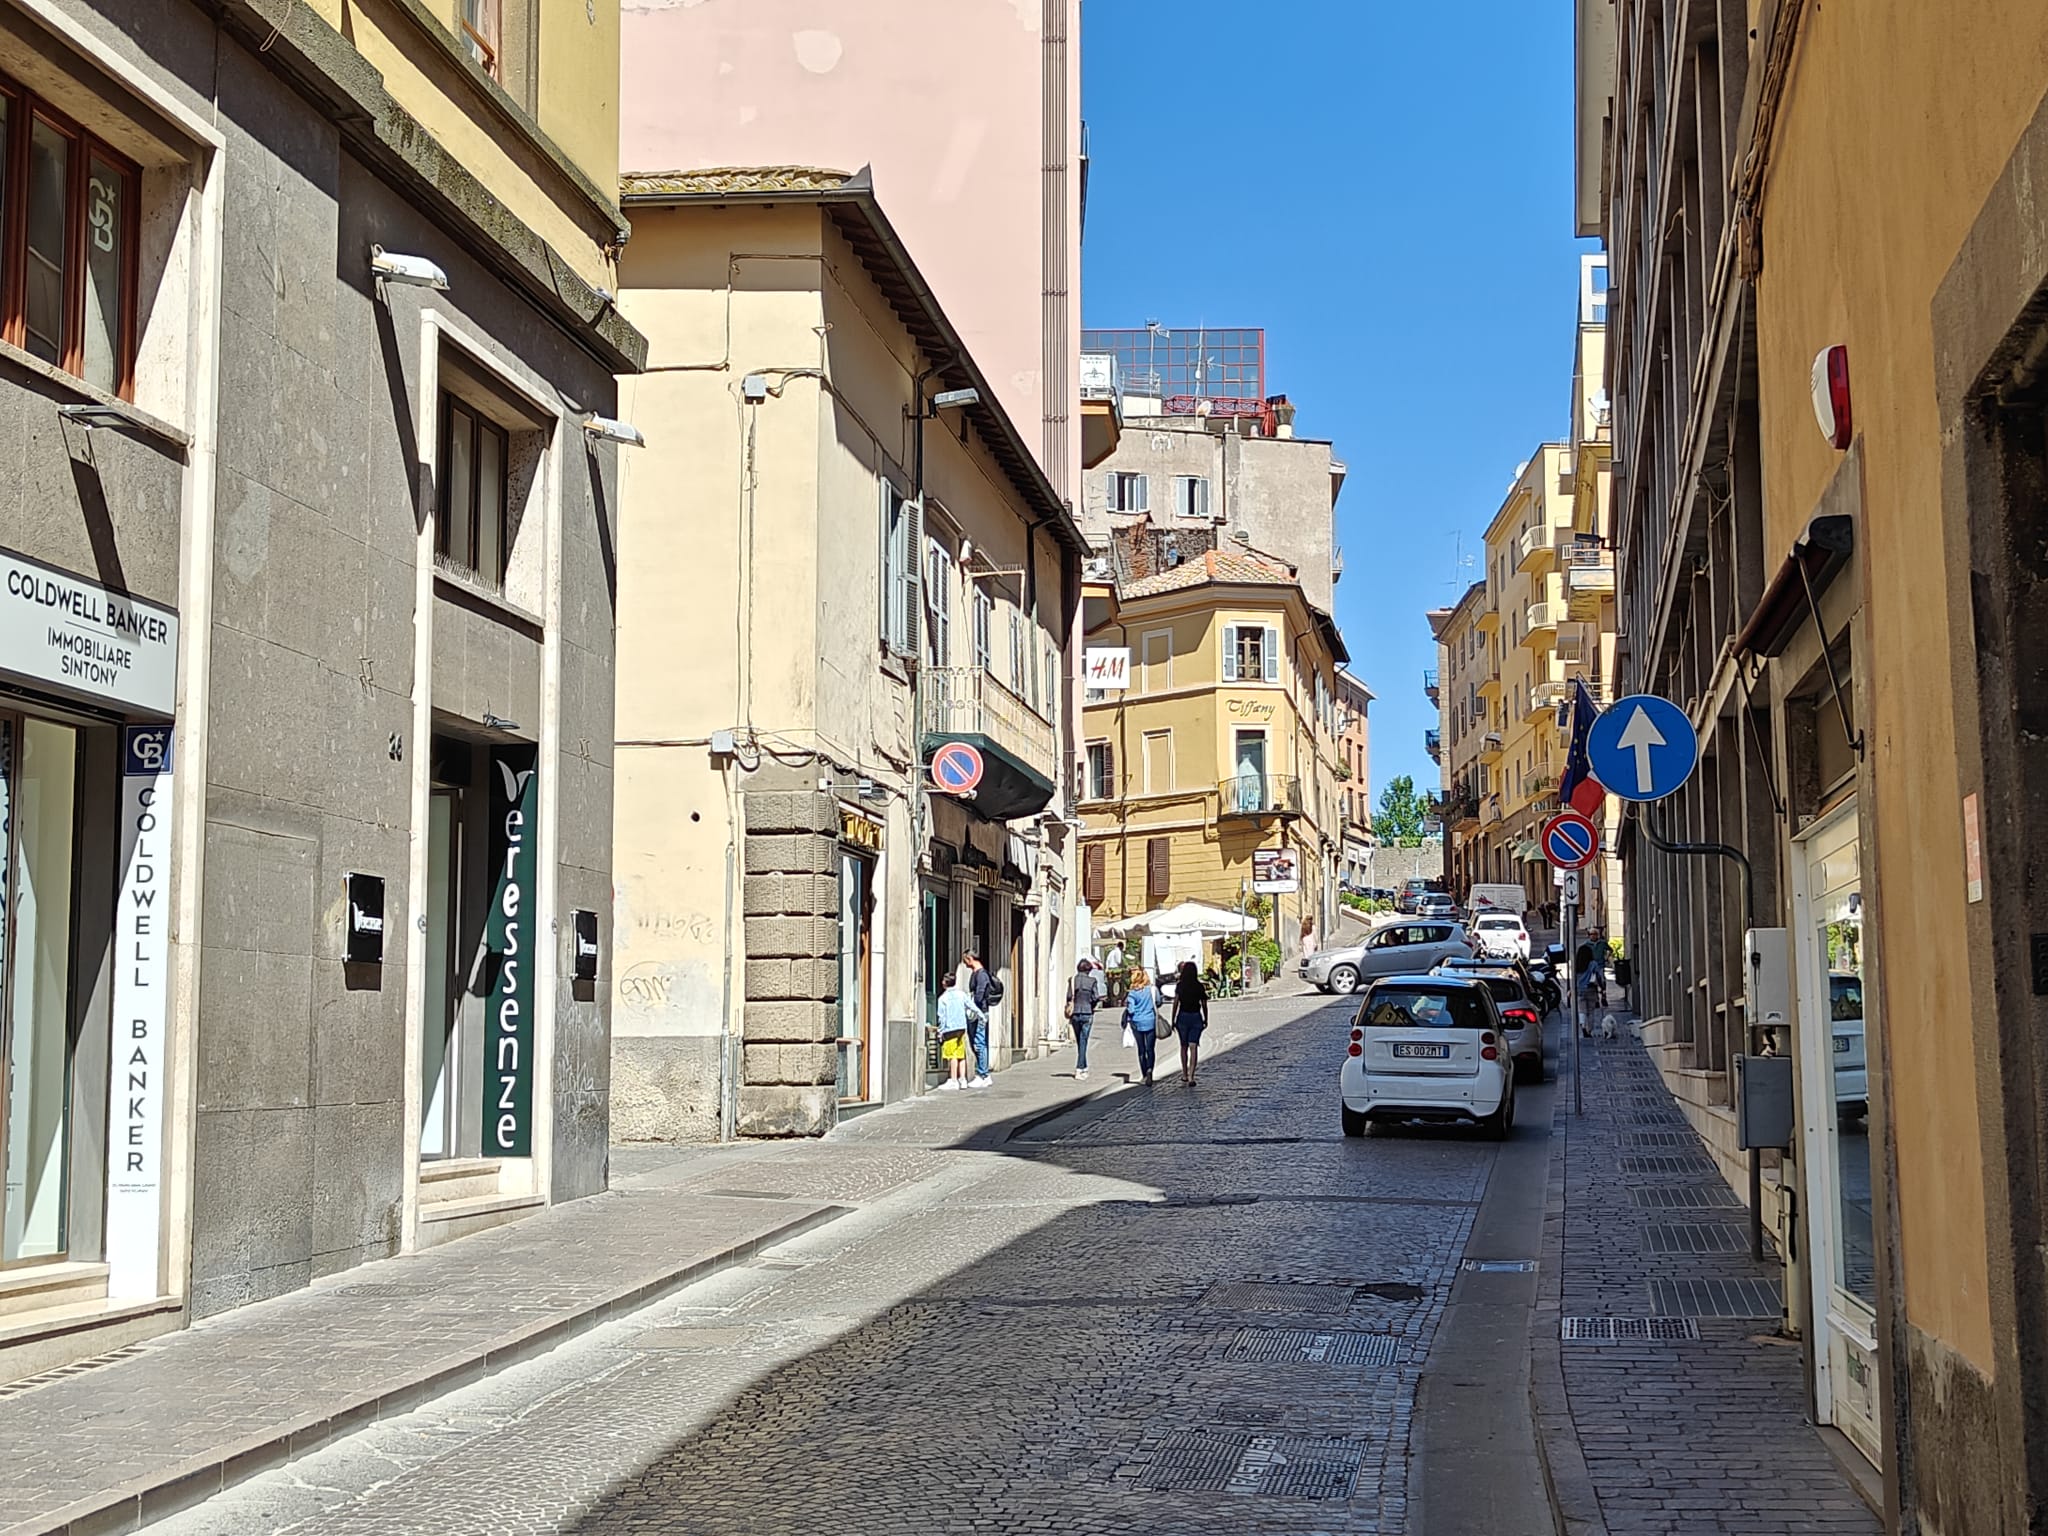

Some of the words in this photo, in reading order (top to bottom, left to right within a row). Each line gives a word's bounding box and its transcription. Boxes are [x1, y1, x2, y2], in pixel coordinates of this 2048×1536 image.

[7, 569, 101, 623] COLDWELL
[106, 600, 168, 645] BANKER
[48, 627, 132, 670] IMMOBILIARE
[1090, 656, 1126, 680] H&M
[61, 655, 118, 688] SINTONY
[1226, 699, 1276, 722] Tiffany
[132, 787, 157, 987] COLDWELL
[127, 1019, 148, 1172] BANKER
